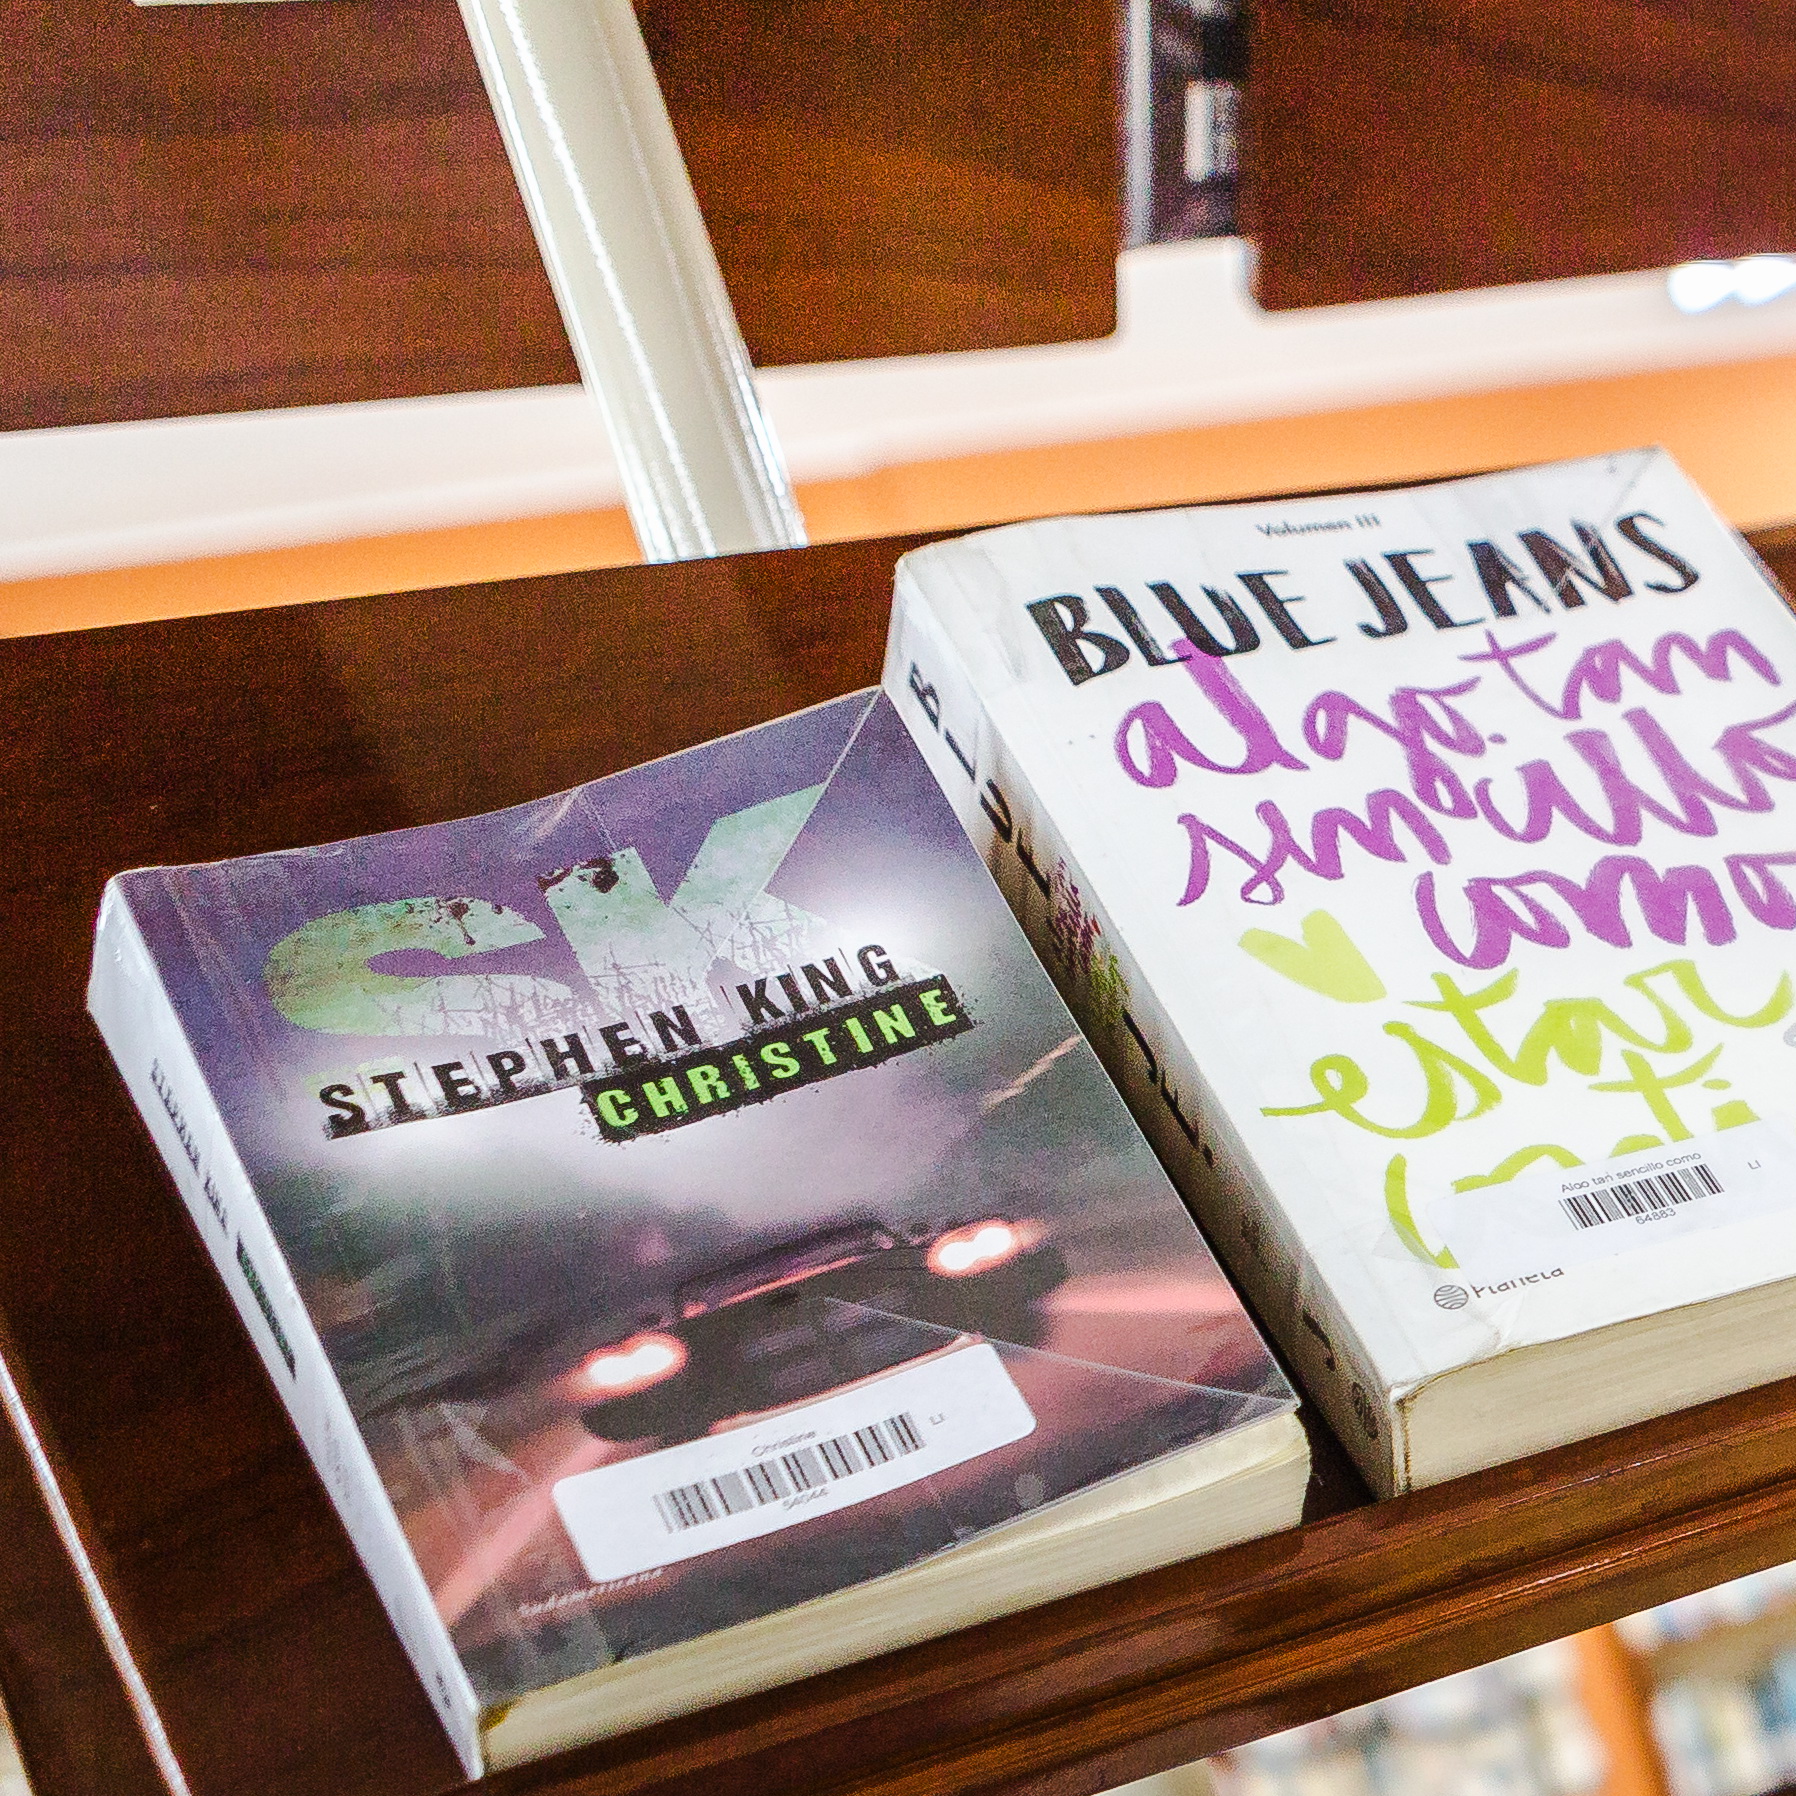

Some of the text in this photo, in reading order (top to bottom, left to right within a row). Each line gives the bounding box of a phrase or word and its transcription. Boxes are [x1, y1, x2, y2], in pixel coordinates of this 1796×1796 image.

[1025, 511, 1702, 688] BLUE JEANS
[1115, 627, 1784, 820] algo tan
[262, 782, 836, 1039] SK
[317, 1003, 701, 1138] STEPHEN
[735, 942, 902, 1025] KING
[595, 985, 958, 1132] CHRISTINE
[1261, 960, 1794, 1139] estar
[1615, 1160, 1665, 1180] sencillo
[1665, 1151, 1703, 1169] como
[1634, 1206, 1678, 1226] 64883
